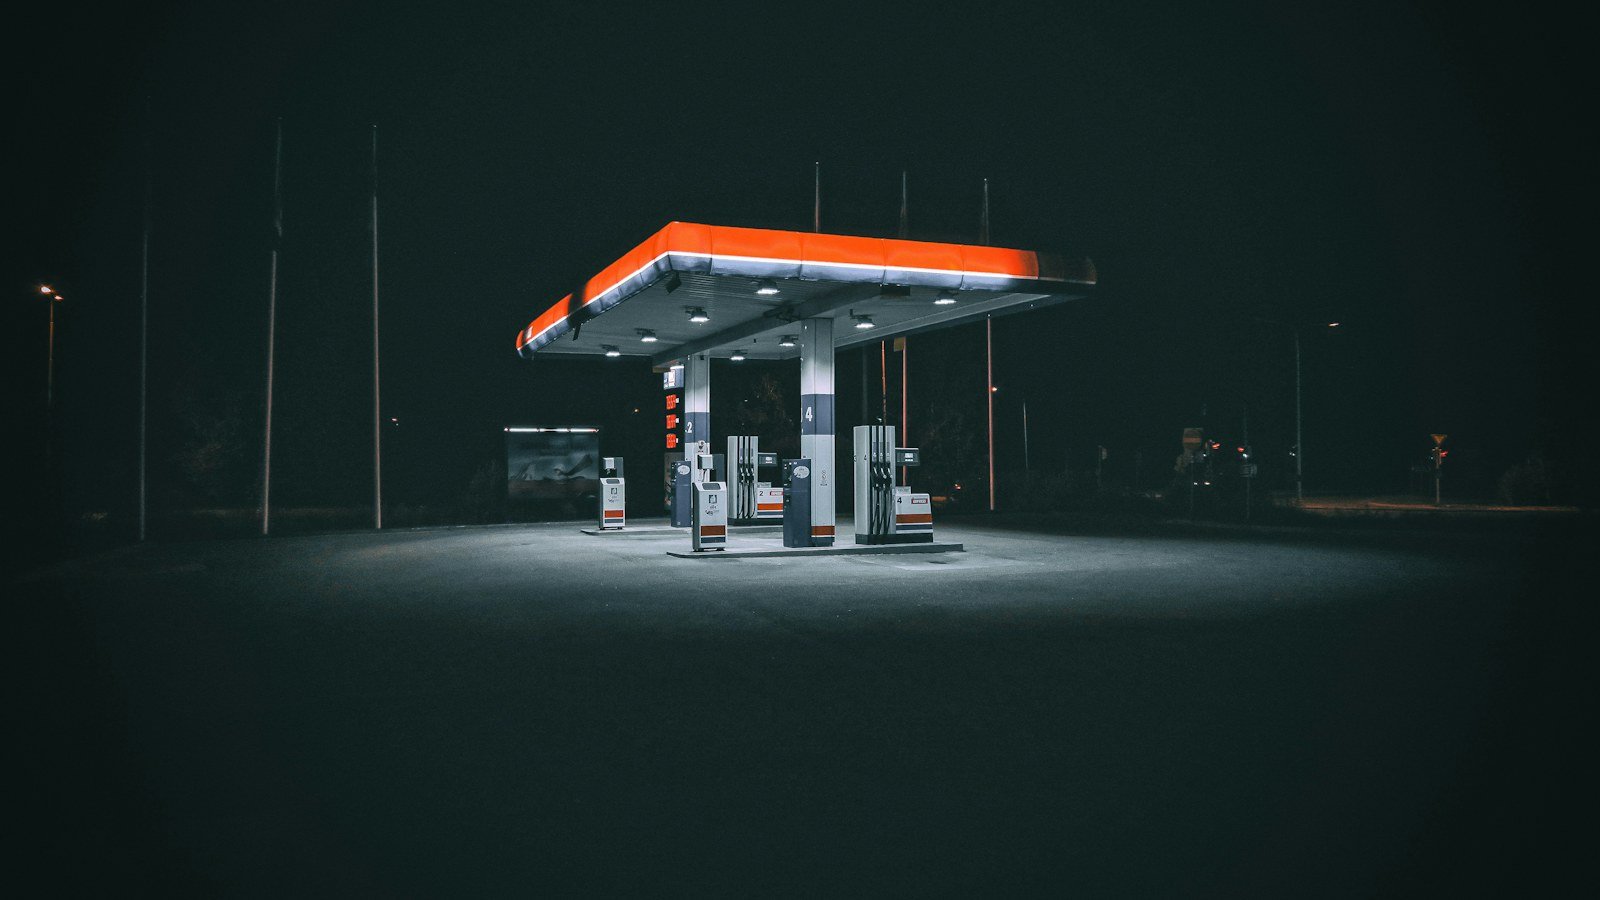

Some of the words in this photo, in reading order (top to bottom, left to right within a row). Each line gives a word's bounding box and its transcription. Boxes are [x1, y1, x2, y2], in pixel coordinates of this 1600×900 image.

[805, 406, 813, 422] 4
[687, 421, 693, 434] 2
[897, 496, 903, 504] 4
